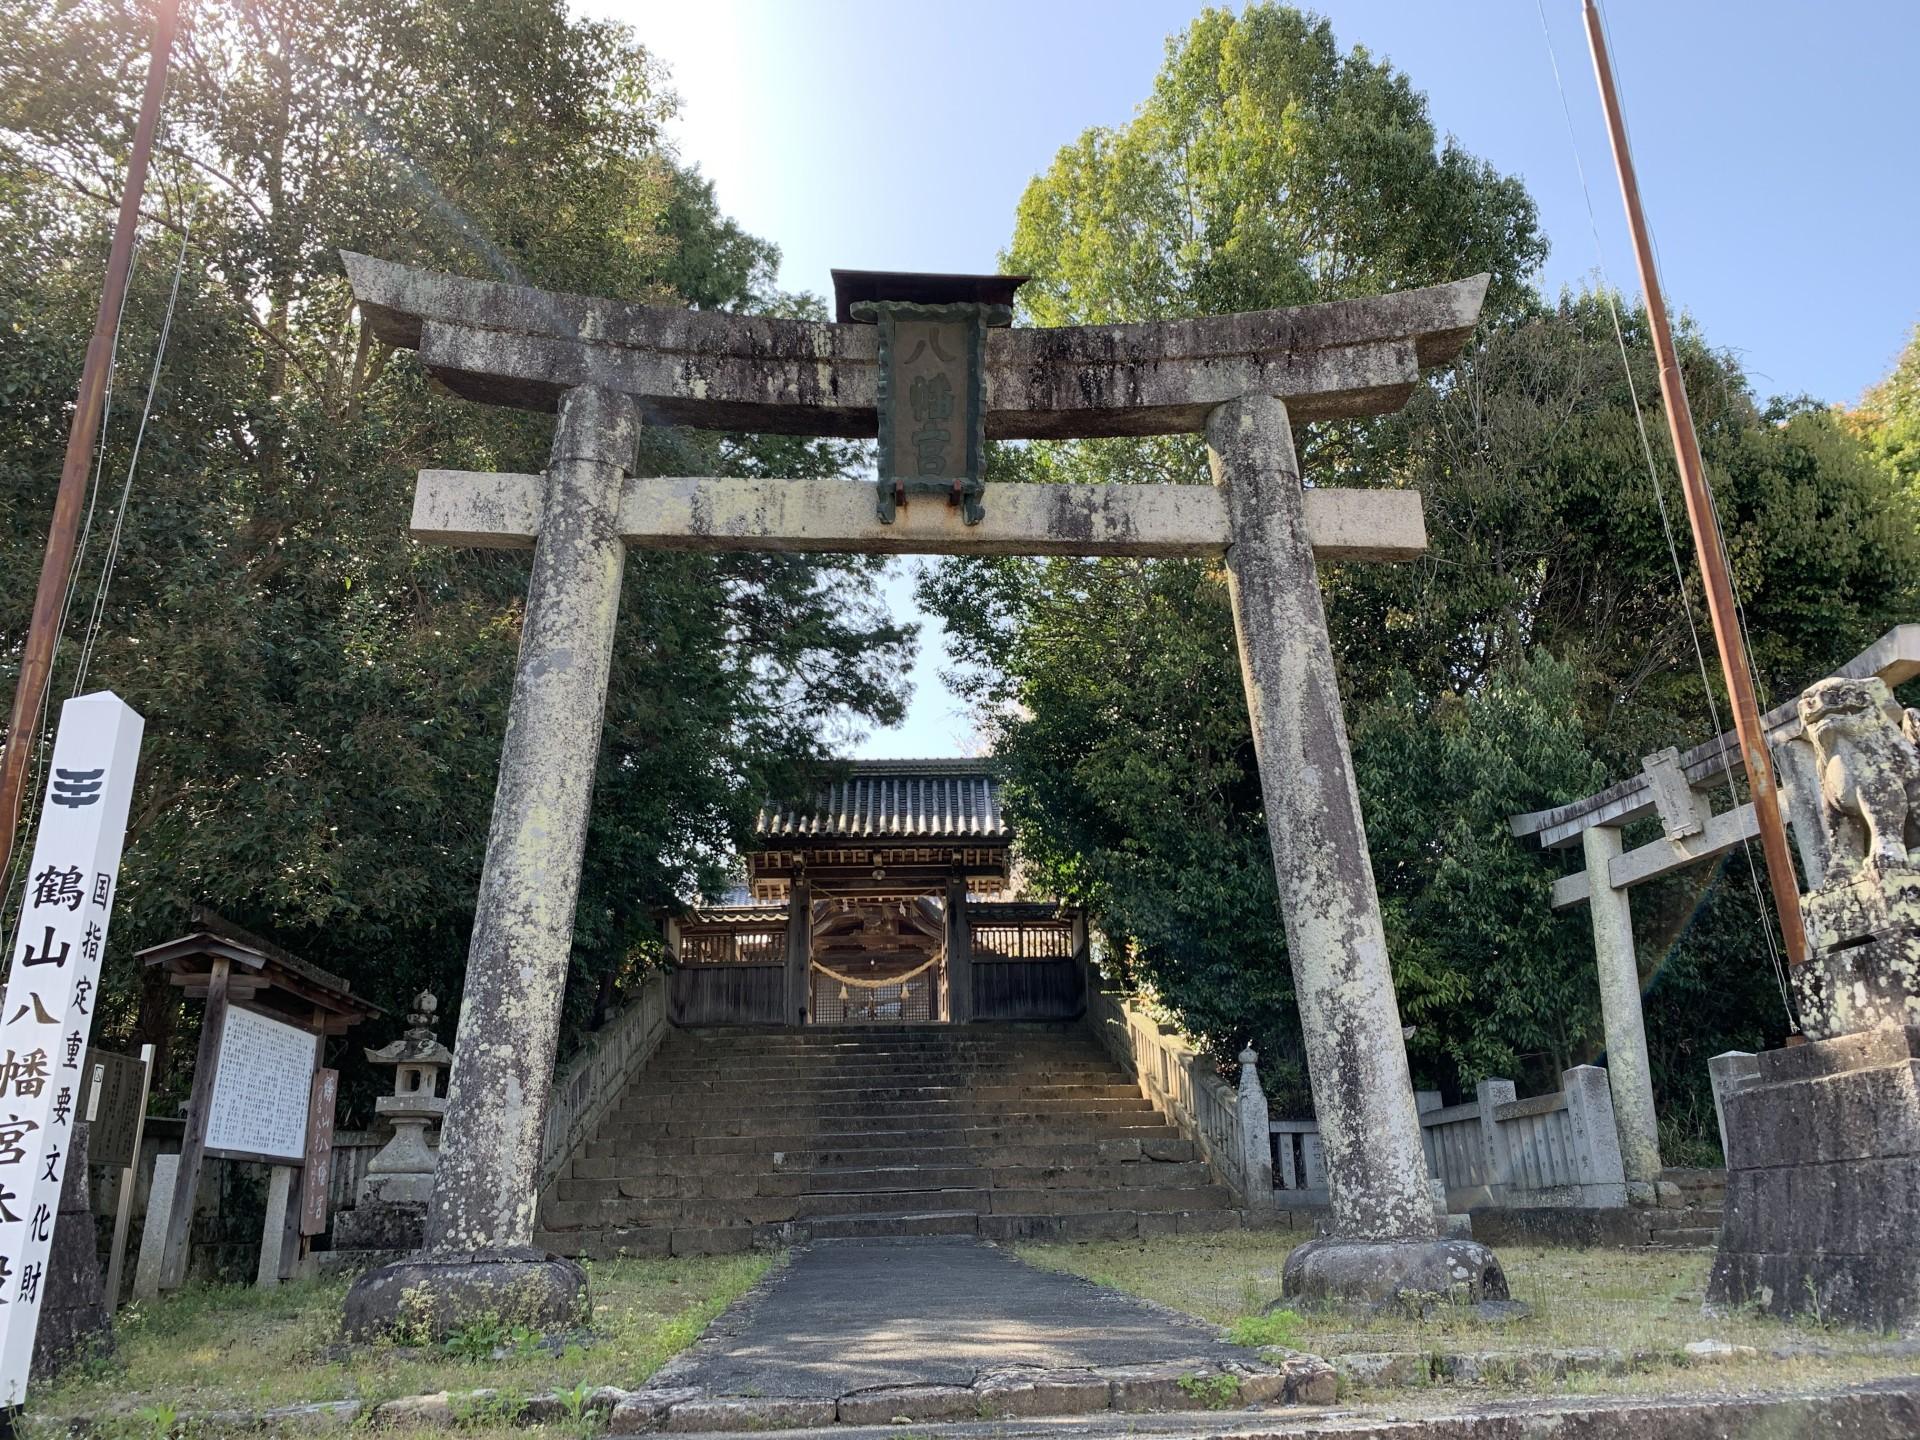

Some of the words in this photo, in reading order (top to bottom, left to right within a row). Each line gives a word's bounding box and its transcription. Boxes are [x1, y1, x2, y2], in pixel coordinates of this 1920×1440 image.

[903, 326, 958, 477] 八幡宮
[18, 871, 112, 1305] 国指定重要文化財
